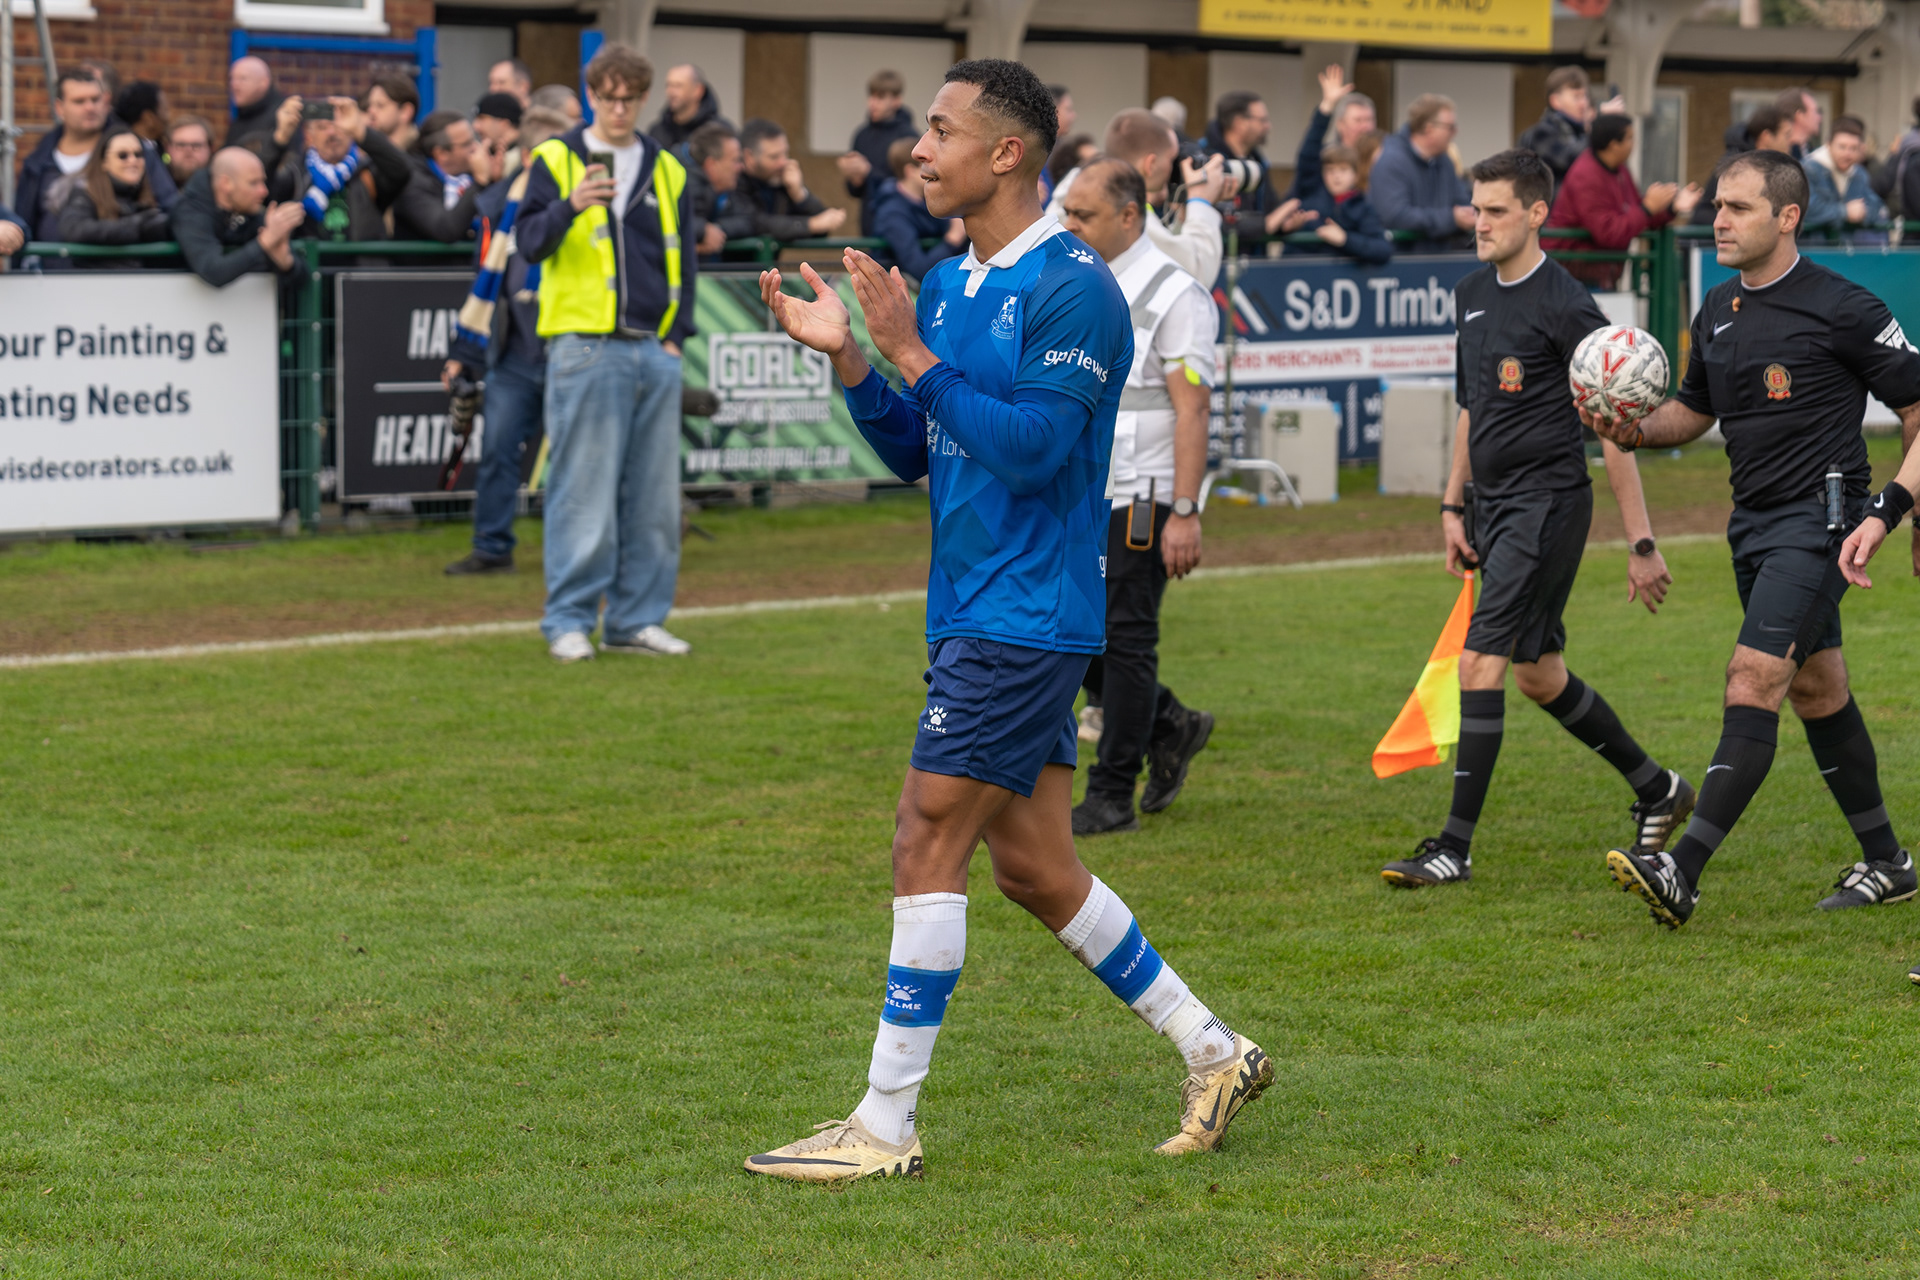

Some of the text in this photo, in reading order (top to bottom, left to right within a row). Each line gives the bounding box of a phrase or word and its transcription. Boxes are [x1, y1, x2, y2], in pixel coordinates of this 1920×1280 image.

[1285, 276, 1457, 331] S&D Timb
[55, 323, 195, 360] Painting
[205, 322, 228, 354] &
[719, 344, 824, 387] GOALS
[88, 382, 191, 415] Needs
[923, 723, 947, 734] KELME
[884, 996, 922, 1010] KELME
